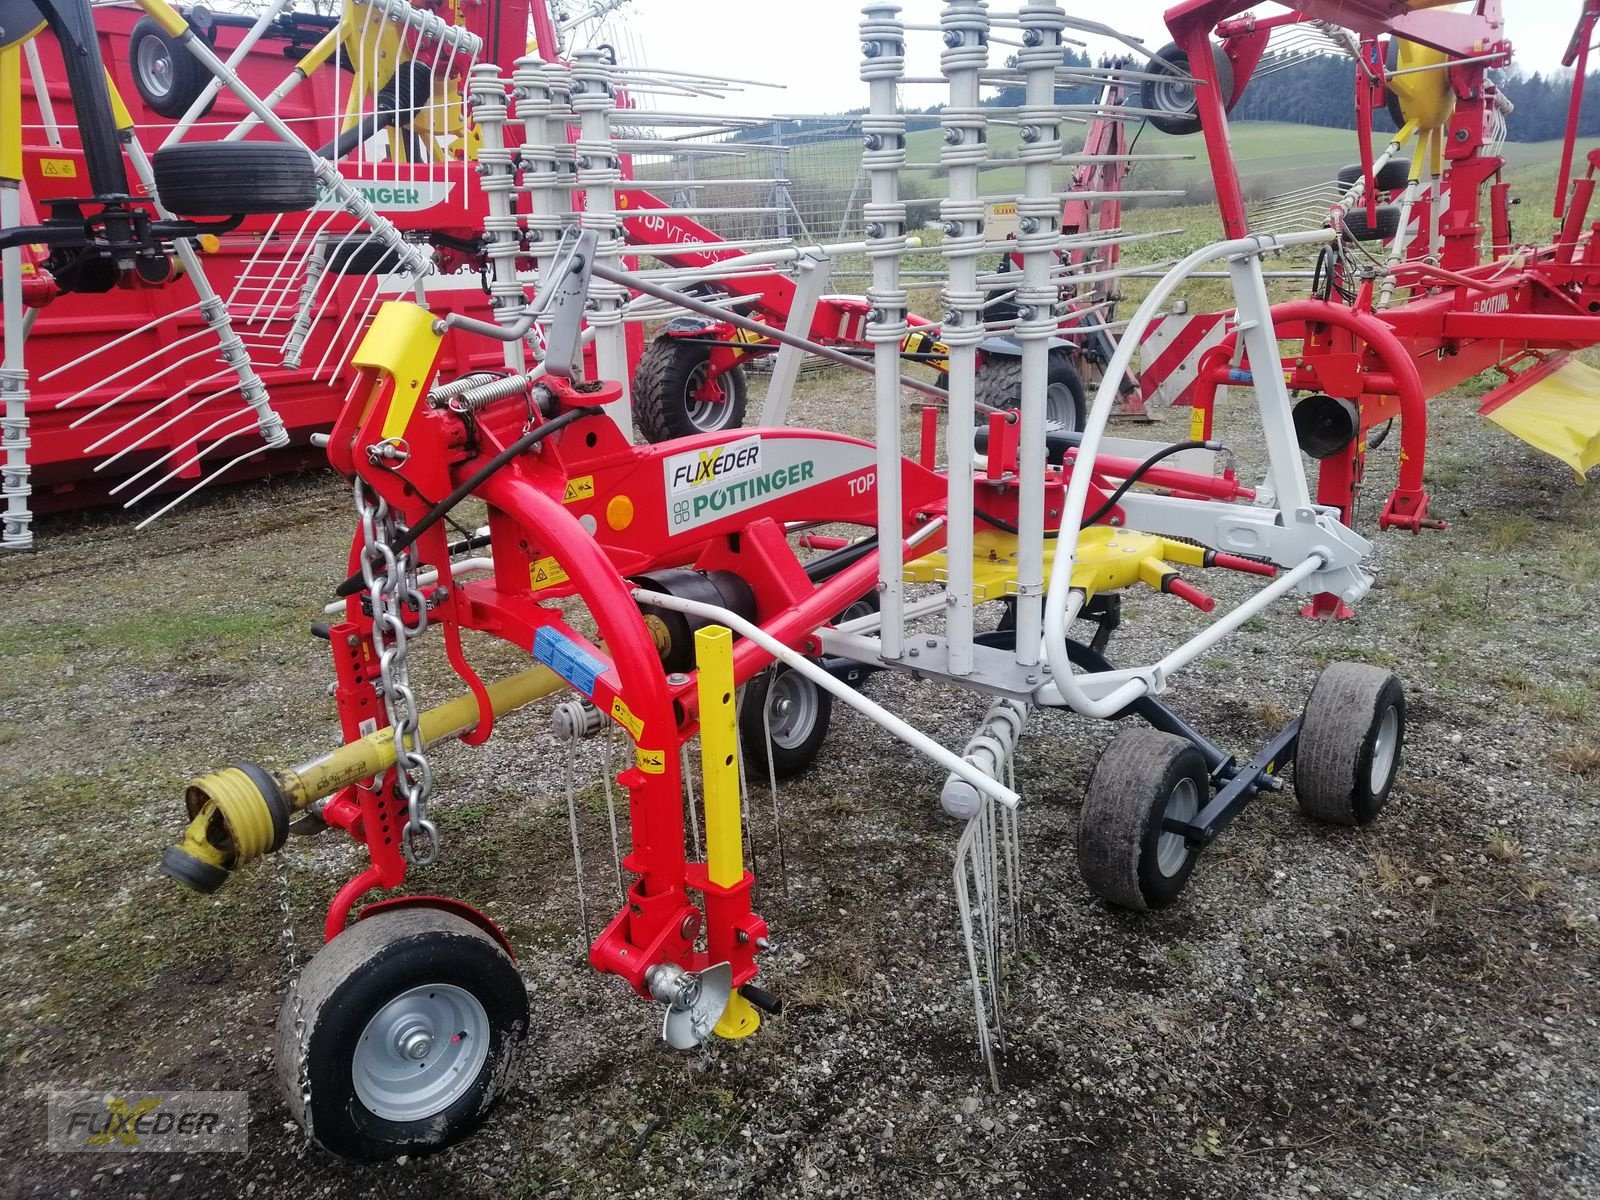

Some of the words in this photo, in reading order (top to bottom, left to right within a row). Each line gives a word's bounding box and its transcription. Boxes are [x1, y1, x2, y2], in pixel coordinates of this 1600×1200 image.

[637, 205, 665, 232] TOP
[673, 446, 759, 487] FLIXEDER
[693, 460, 814, 518] PÖTTINGER
[847, 472, 876, 497] TOP
